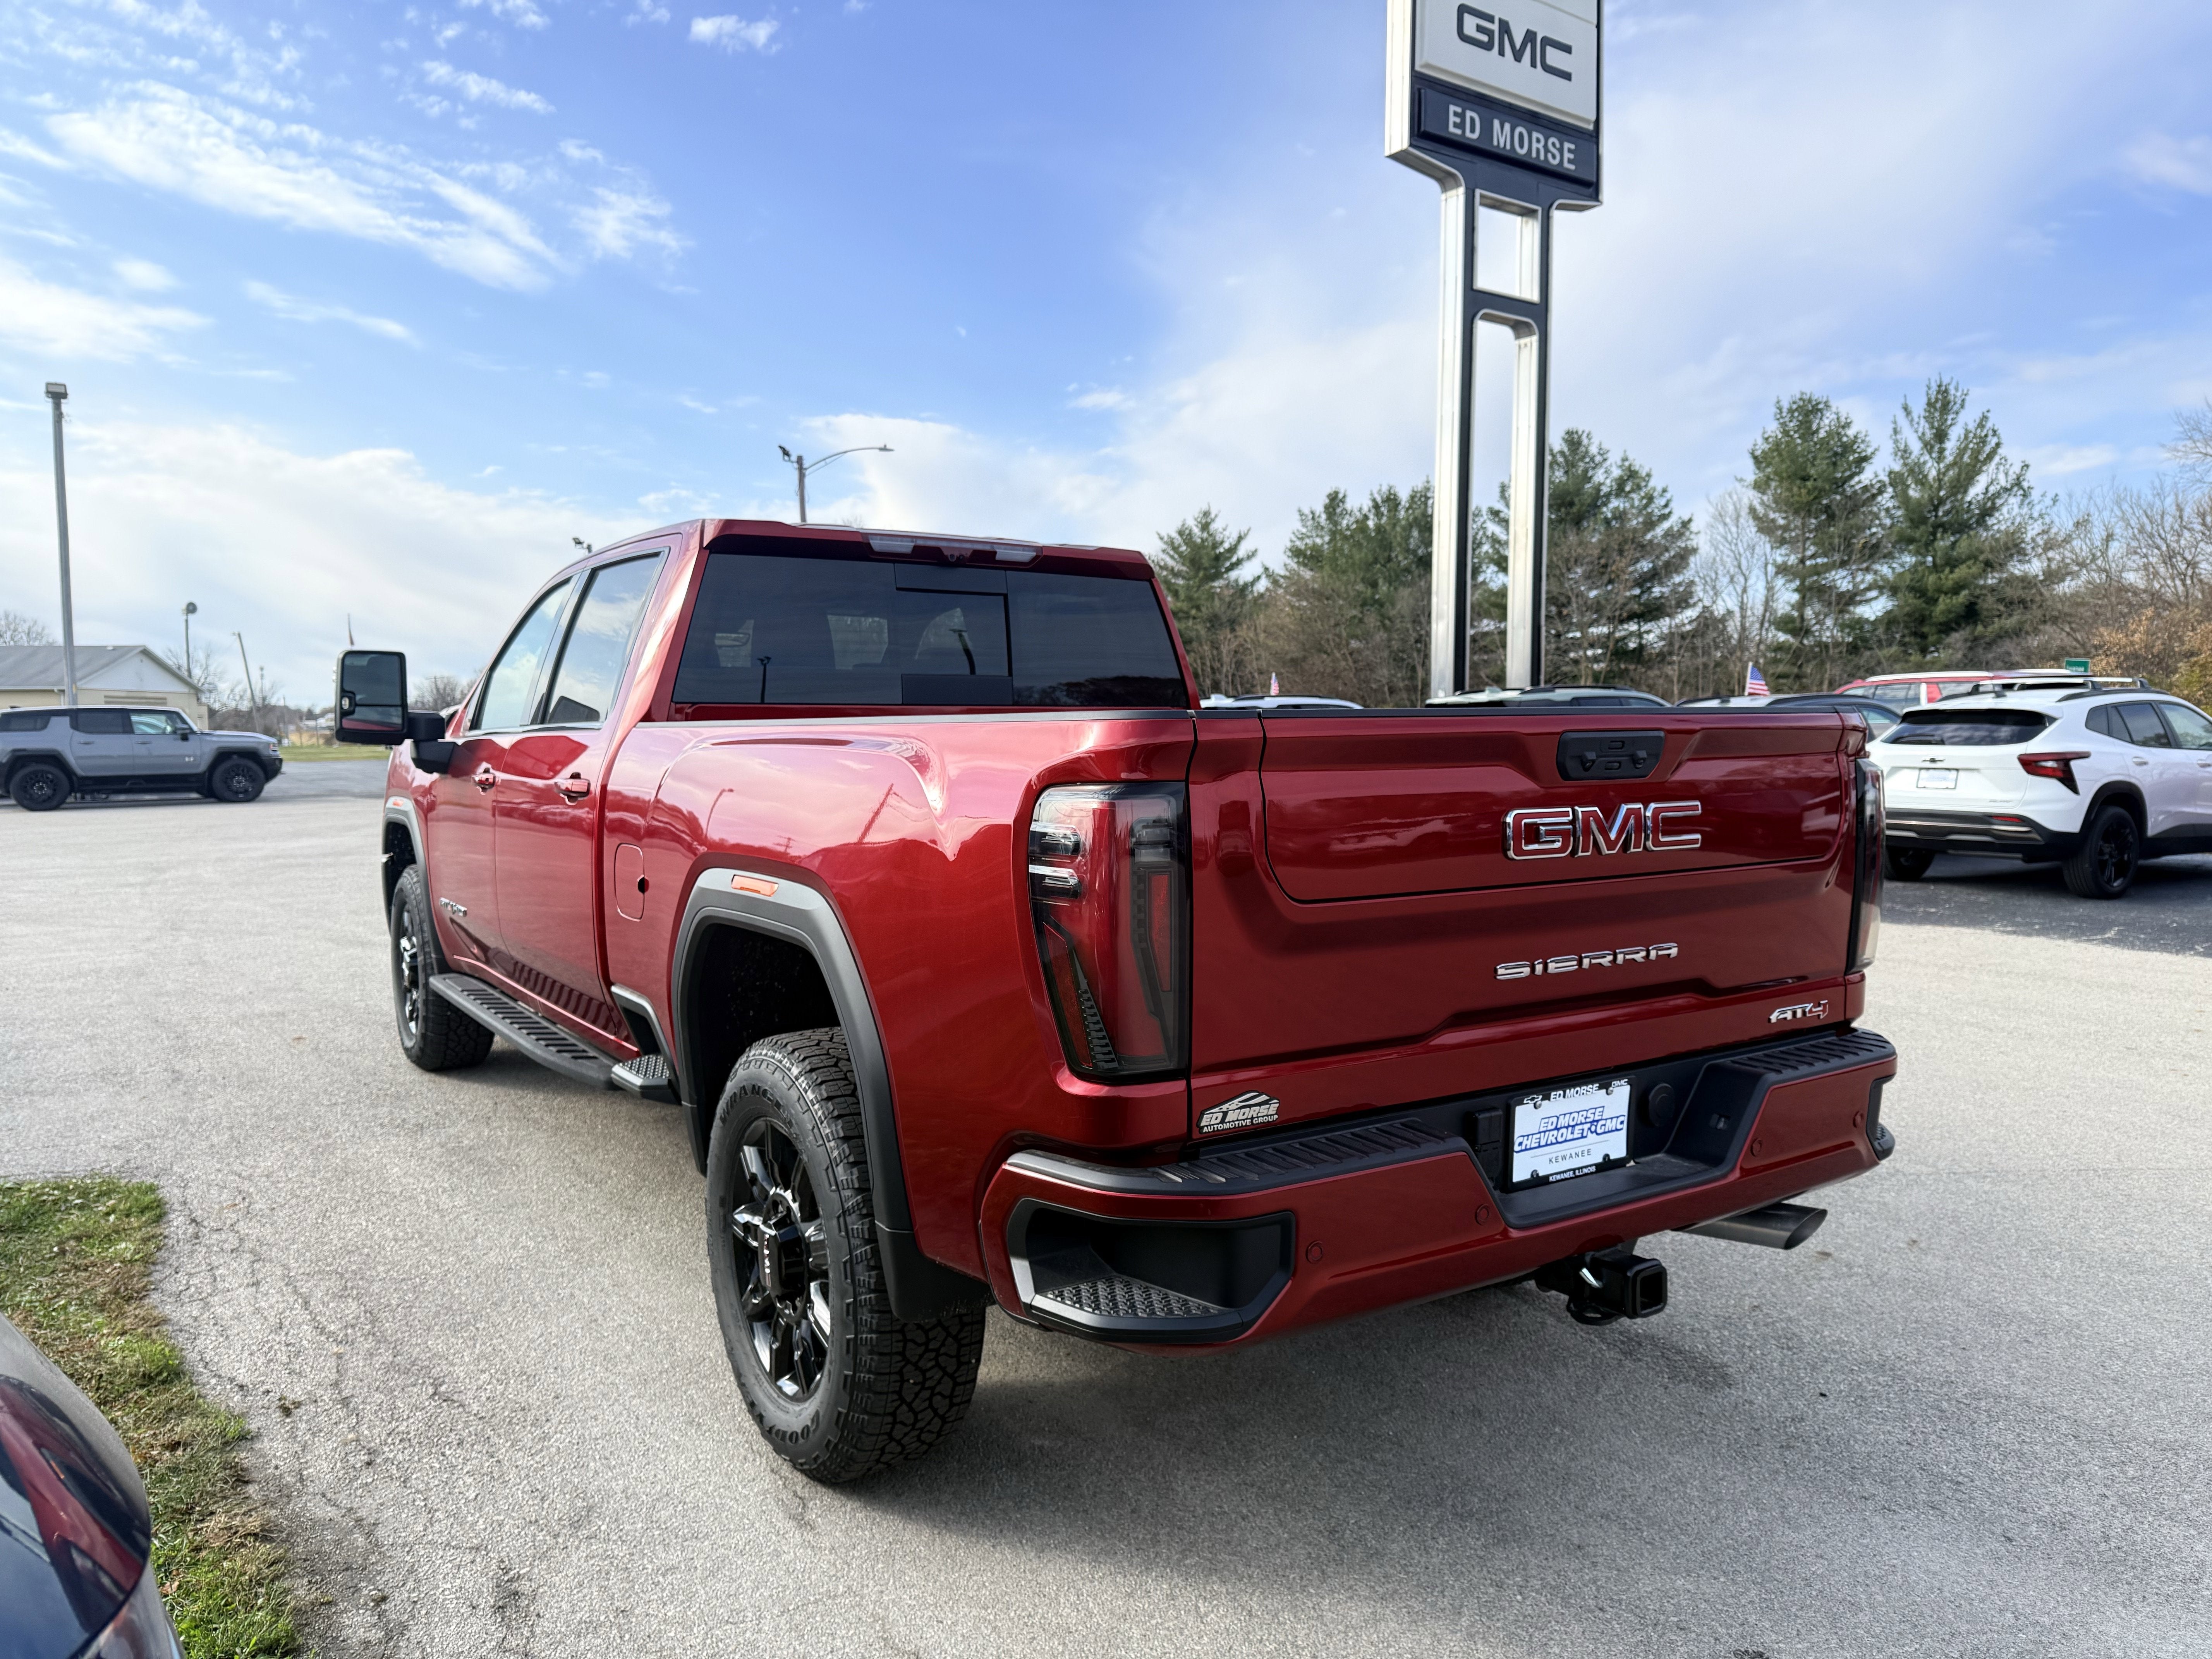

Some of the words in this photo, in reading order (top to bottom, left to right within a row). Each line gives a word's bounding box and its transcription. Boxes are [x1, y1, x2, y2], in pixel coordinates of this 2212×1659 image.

[1457, 3, 1572, 82] GMC
[1448, 104, 1480, 140] ED
[1493, 118, 1576, 170] MORSE
[1506, 800, 1702, 860] GMC
[1496, 943, 1678, 980] SIERRA
[1769, 1000, 1828, 1023] AT4
[1550, 1091, 1563, 1101] ED
[1565, 1084, 1599, 1099] MORSE
[1612, 1079, 1628, 1087] GMC
[1200, 1112, 1223, 1127] ED
[1225, 1103, 1279, 1122] MORSE
[1203, 1119, 1252, 1133] AUTOMOTIVE
[1253, 1115, 1278, 1124] GROUP
[1539, 1116, 1558, 1132] ED
[1557, 1106, 1605, 1127] MORSE
[1549, 1149, 1592, 1164] KEWANEE
[1575, 1166, 1596, 1176] ILLINOIS
